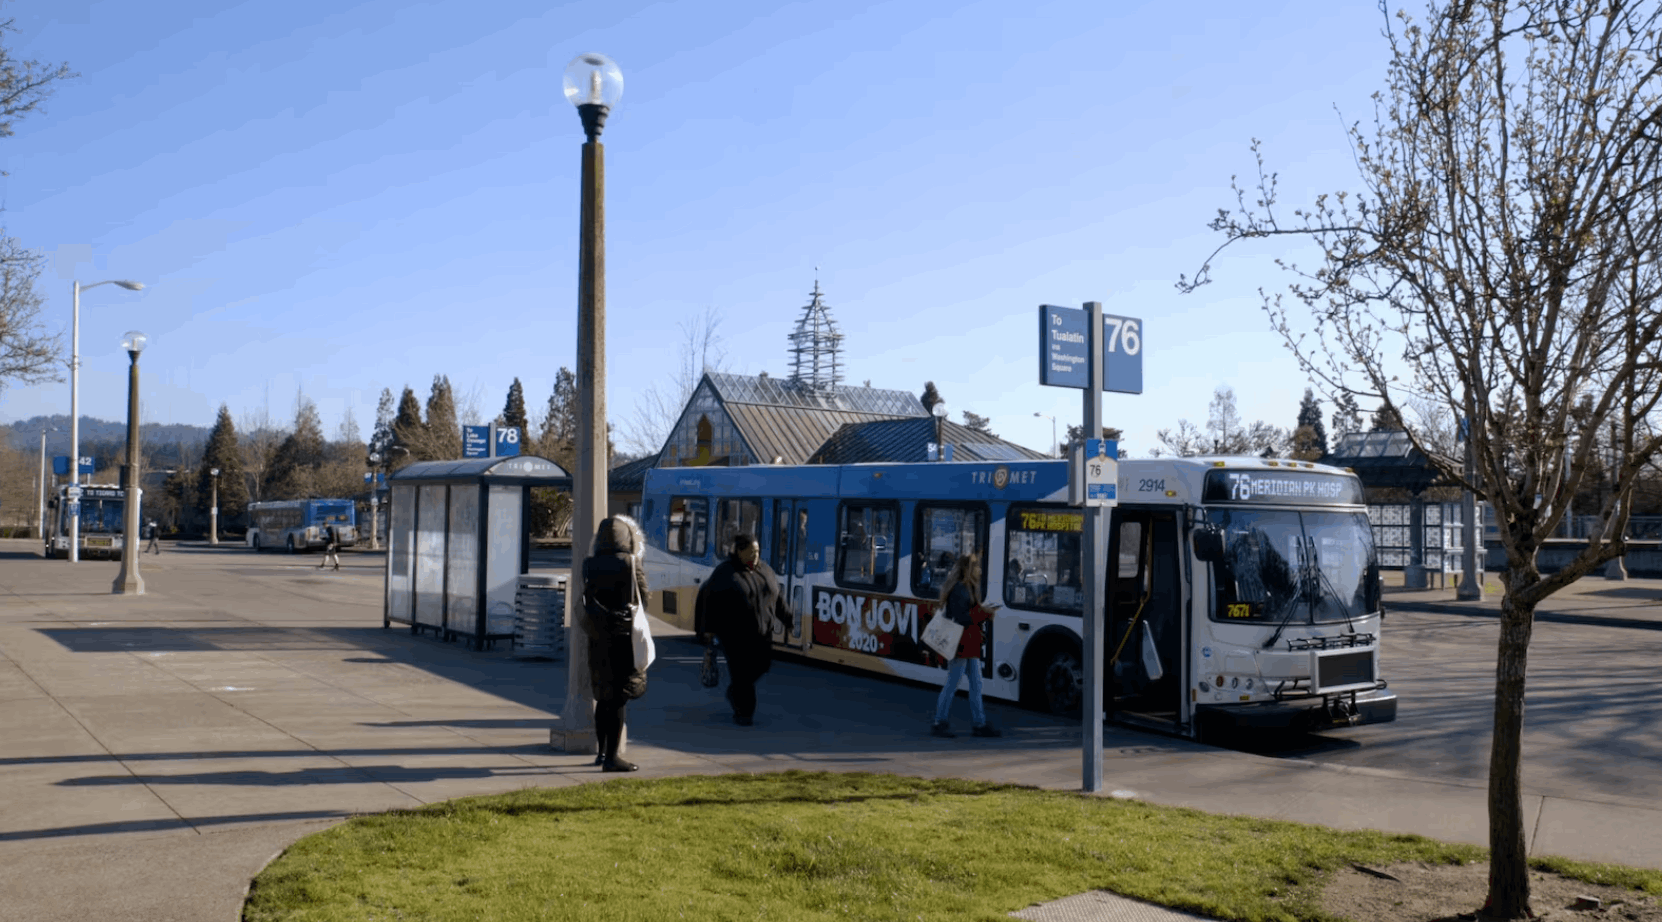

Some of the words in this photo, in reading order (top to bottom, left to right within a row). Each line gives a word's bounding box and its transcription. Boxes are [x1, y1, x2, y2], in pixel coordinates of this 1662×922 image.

[1051, 313, 1063, 326] To
[1051, 329, 1084, 344] Tualatin
[1105, 317, 1140, 356] 76
[1051, 352, 1085, 364] Washington
[1051, 362, 1072, 373] Square
[497, 428, 519, 444] 78
[79, 456, 92, 466] 42
[1089, 464, 1102, 476] 76
[1138, 478, 1165, 492] 2914
[1229, 473, 1251, 500] 76
[1251, 479, 1301, 496] MERIDIAN
[1303, 481, 1316, 496] PK
[1317, 481, 1342, 498] HOSP
[1021, 512, 1036, 530] 76
[815, 591, 865, 628] BON
[865, 598, 918, 645] JOVI
[848, 633, 878, 653] 2020
